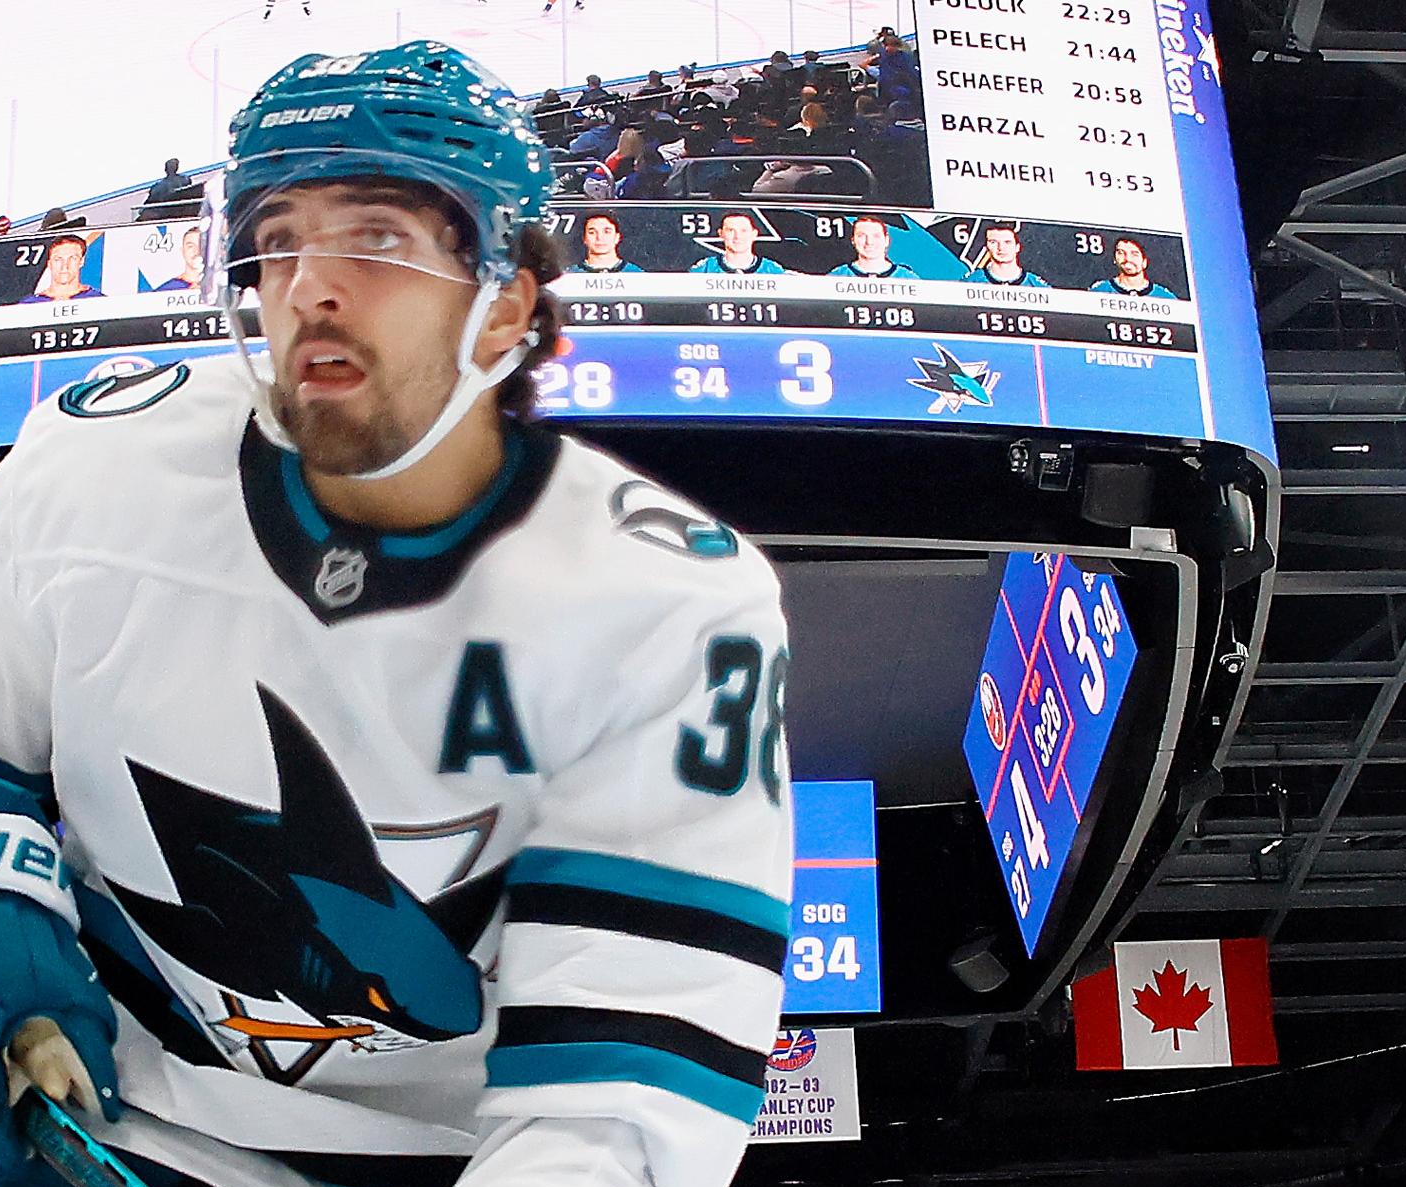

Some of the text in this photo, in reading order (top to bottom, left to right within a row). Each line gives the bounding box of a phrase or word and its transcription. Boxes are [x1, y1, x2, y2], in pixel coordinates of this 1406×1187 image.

[1062, 3, 1131, 25] 22:29
[933, 29, 1137, 63] PELECH 21:44
[937, 70, 1142, 105] SCHAEFER 20:58
[942, 114, 1147, 148] BARZAL 20:21
[946, 159, 1154, 193] PALMIERI 19:53
[682, 214, 711, 233] 53
[816, 217, 844, 238] 81
[953, 224, 969, 244] 6
[144, 233, 174, 253] 44
[1075, 233, 1104, 255] 38
[15, 245, 45, 267] 27
[585, 278, 625, 290] MISA
[706, 279, 777, 291] SKINNER
[834, 281, 917, 297] GAUDETTE
[966, 287, 1049, 304] DICKINSON
[53, 304, 80, 318] LEE
[570, 303, 643, 321] 12:10
[708, 303, 778, 322] 15:11
[843, 306, 915, 327] 13:08
[1100, 298, 1171, 316] FERRARO
[978, 313, 1046, 334] 15:05
[1106, 322, 1173, 346] 18:52
[31, 326, 99, 349] 13:27
[679, 344, 720, 361] SOG
[1085, 350, 1154, 369] PENALTY
[674, 366, 730, 399] 34
[779, 340, 834, 406] 3
[1059, 586, 1107, 715] 3
[438, 640, 537, 774] A
[1011, 759, 1051, 870] 4
[803, 904, 846, 924] SOG
[791, 936, 861, 981] 34
[808, 1098, 835, 1113] CUP
